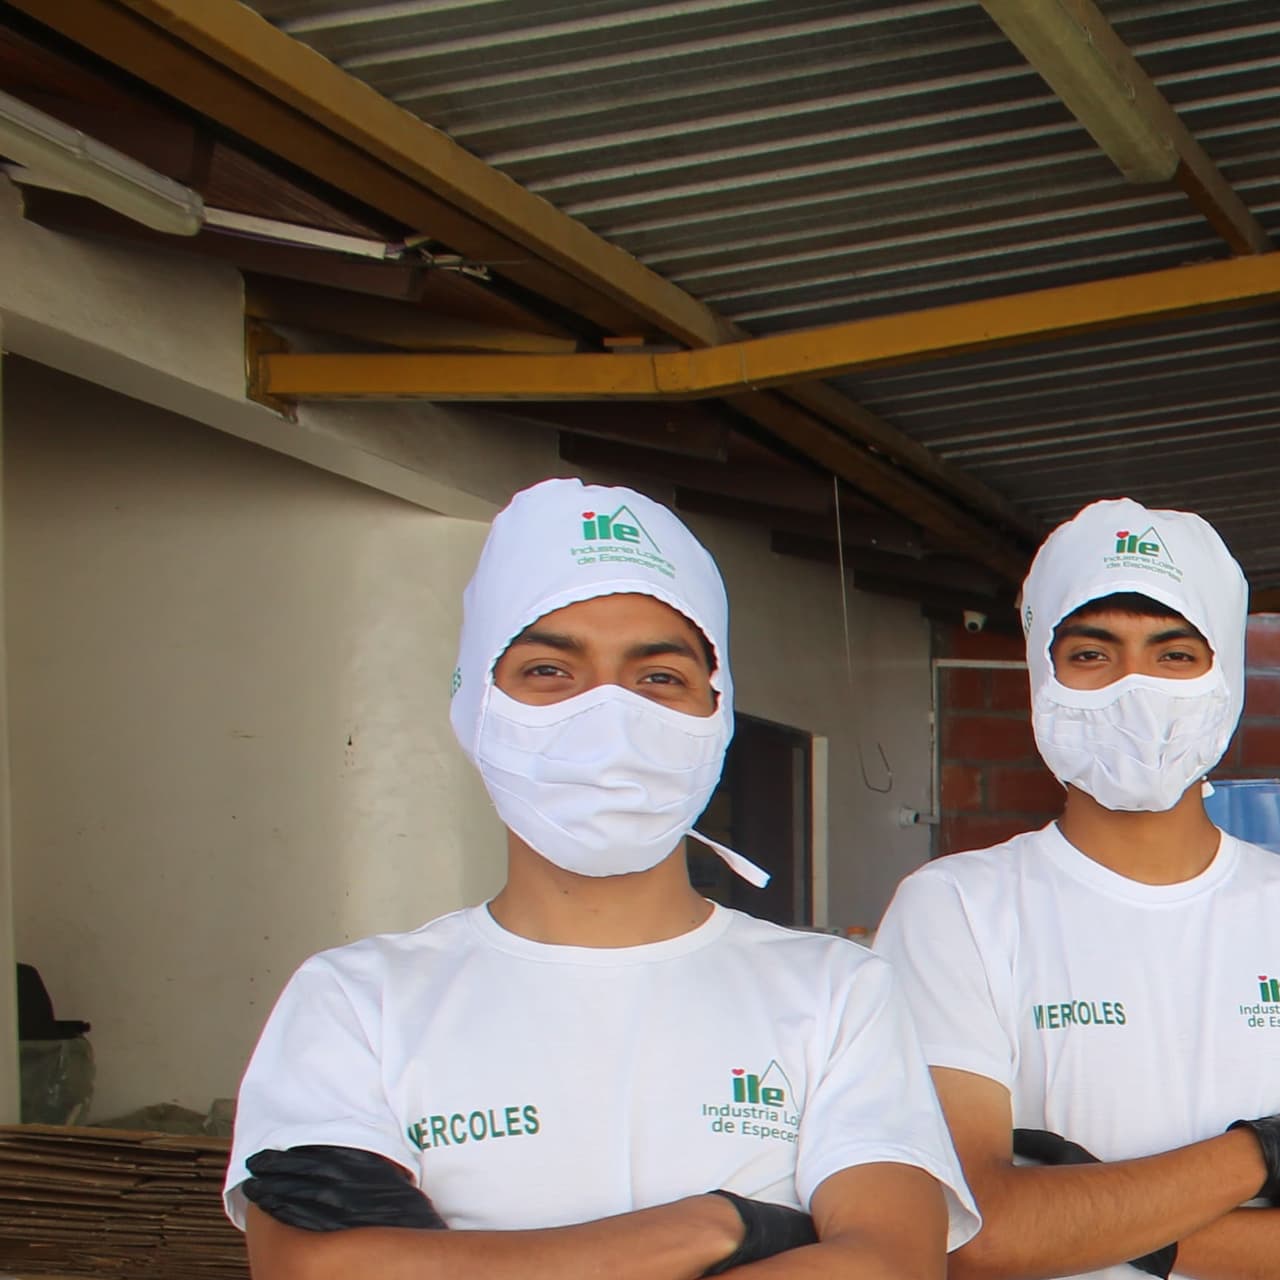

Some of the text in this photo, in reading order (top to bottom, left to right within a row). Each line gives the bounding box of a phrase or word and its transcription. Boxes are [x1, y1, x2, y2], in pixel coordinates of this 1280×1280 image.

[582, 511, 640, 544] ile
[1115, 530, 1160, 558] ile
[1247, 1015, 1265, 1028] de
[731, 1068, 785, 1108] ile
[701, 1103, 779, 1123] Industria
[711, 1117, 736, 1134] de
